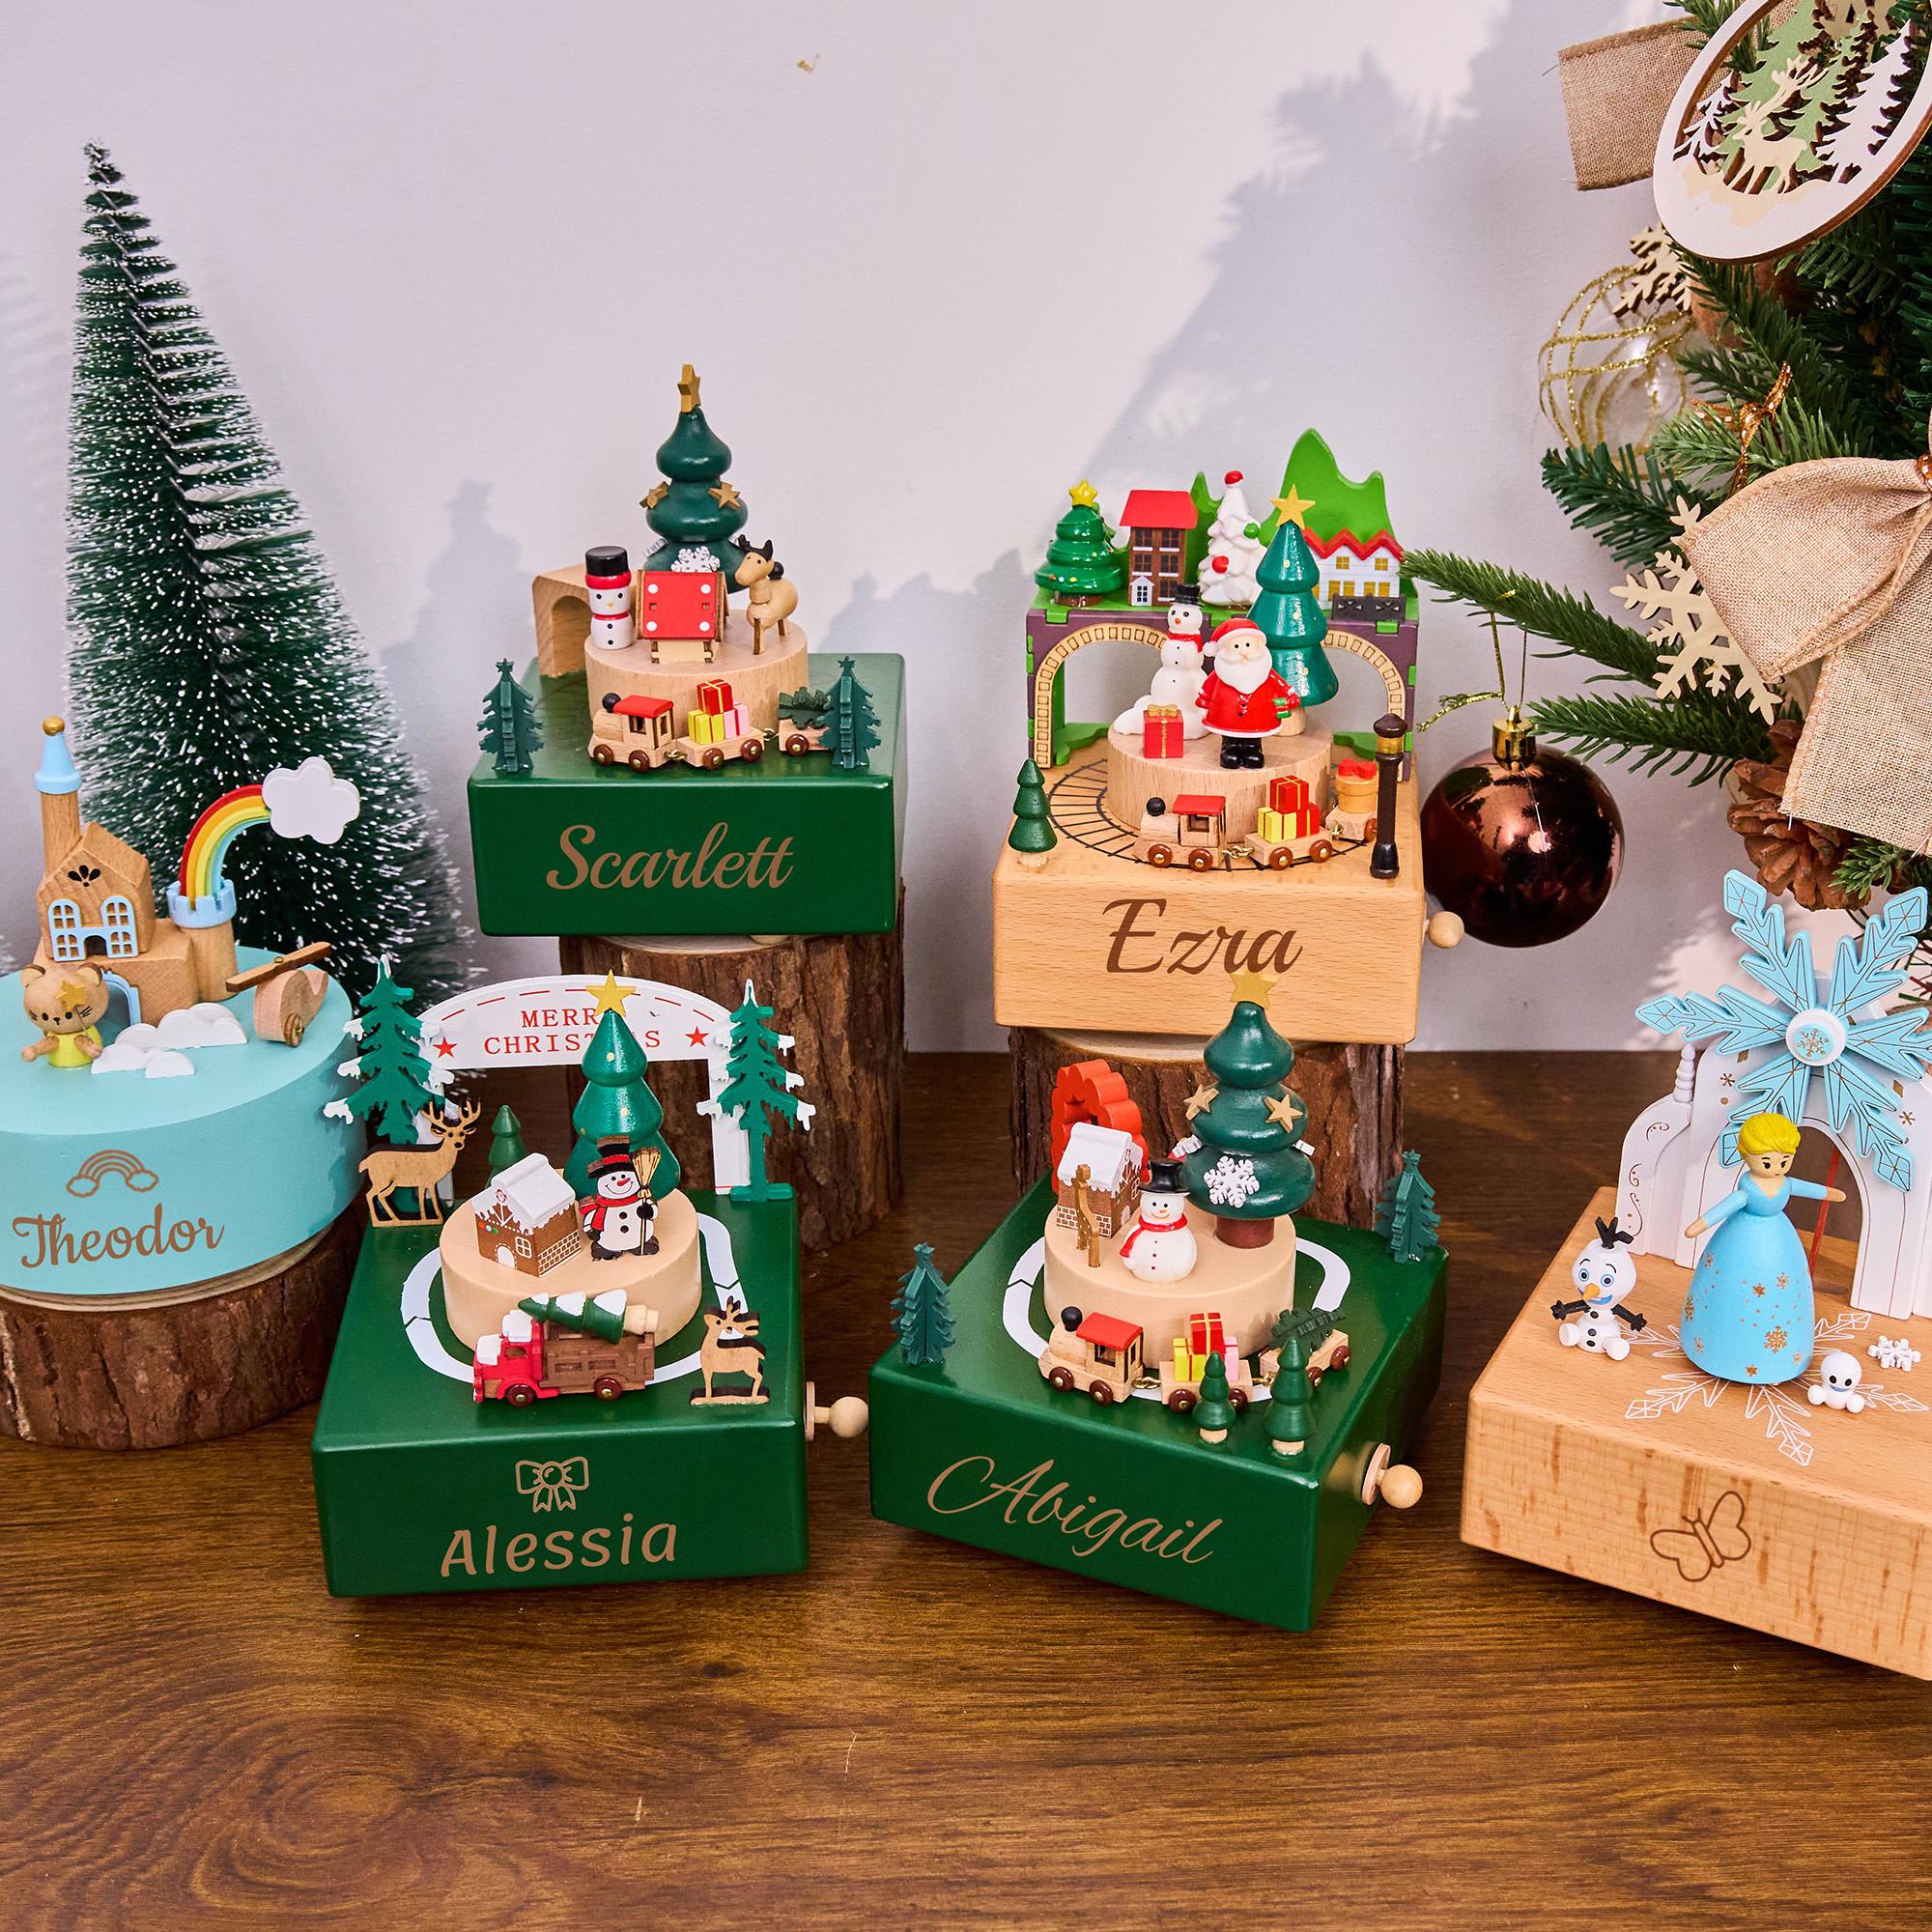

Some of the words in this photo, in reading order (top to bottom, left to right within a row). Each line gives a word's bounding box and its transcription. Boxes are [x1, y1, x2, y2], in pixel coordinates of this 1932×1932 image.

[546, 822, 794, 890] Scarlett
[1101, 898, 1303, 975] Ezra
[521, 1008, 600, 1028] MERR
[12, 1204, 224, 1267] Theodor
[926, 1456, 1224, 1563] Abigail
[440, 1514, 678, 1577] Alessia
